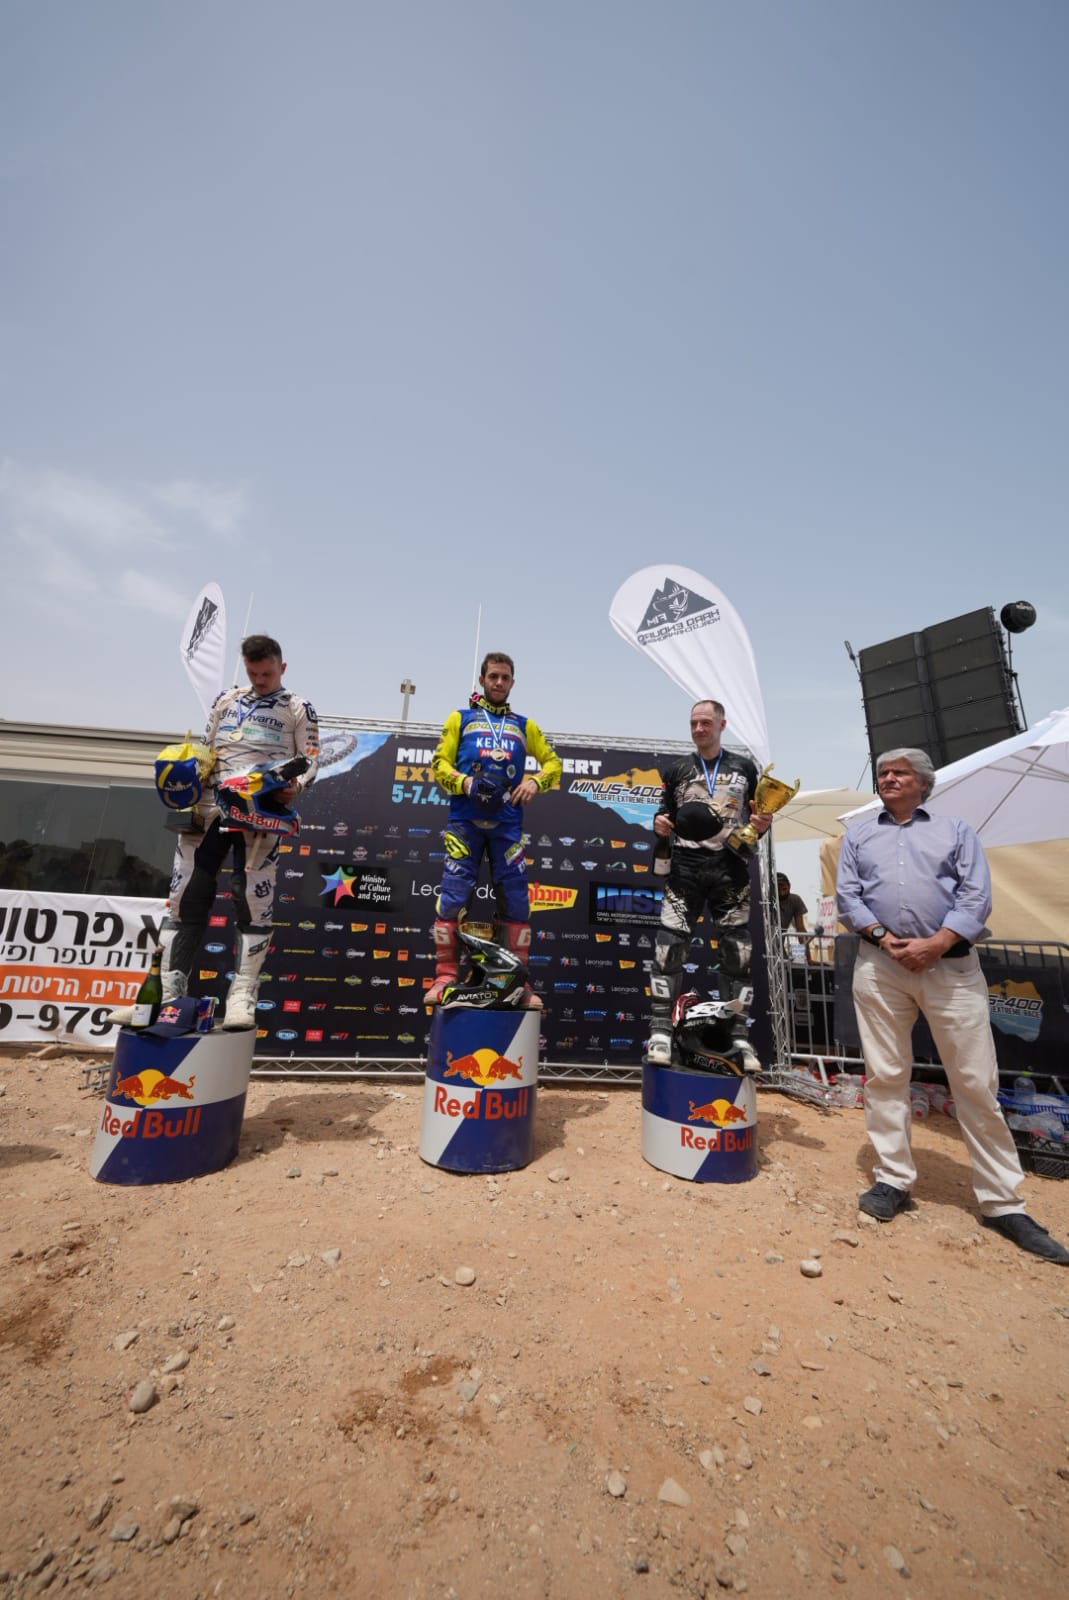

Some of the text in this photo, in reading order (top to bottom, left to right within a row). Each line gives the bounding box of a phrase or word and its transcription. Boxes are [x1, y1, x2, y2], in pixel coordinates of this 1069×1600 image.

[476, 737, 515, 751] KENNY
[396, 747, 602, 775] MIN DERT
[395, 765, 435, 783] EXT
[392, 784, 451, 806] 5-7.4.
[592, 793, 616, 801] DESERT
[617, 795, 646, 804] EXTREME
[230, 806, 256, 823] Red
[254, 813, 281, 830] Bull
[359, 881, 391, 893] of Culture
[361, 874, 387, 885] Ministry
[357, 891, 391, 903] and Sport
[561, 932, 589, 940] Leonardo
[0, 944, 149, 968] דות עפר ופי
[585, 958, 613, 966] Leonardo
[84, 979, 141, 1000] מרים,
[611, 985, 639, 993] Leonardo
[989, 994, 1043, 1011] S-400
[434, 1085, 528, 1120] Red Bull
[101, 1104, 201, 1139] Red Bull
[680, 1126, 753, 1153] Red Bull
